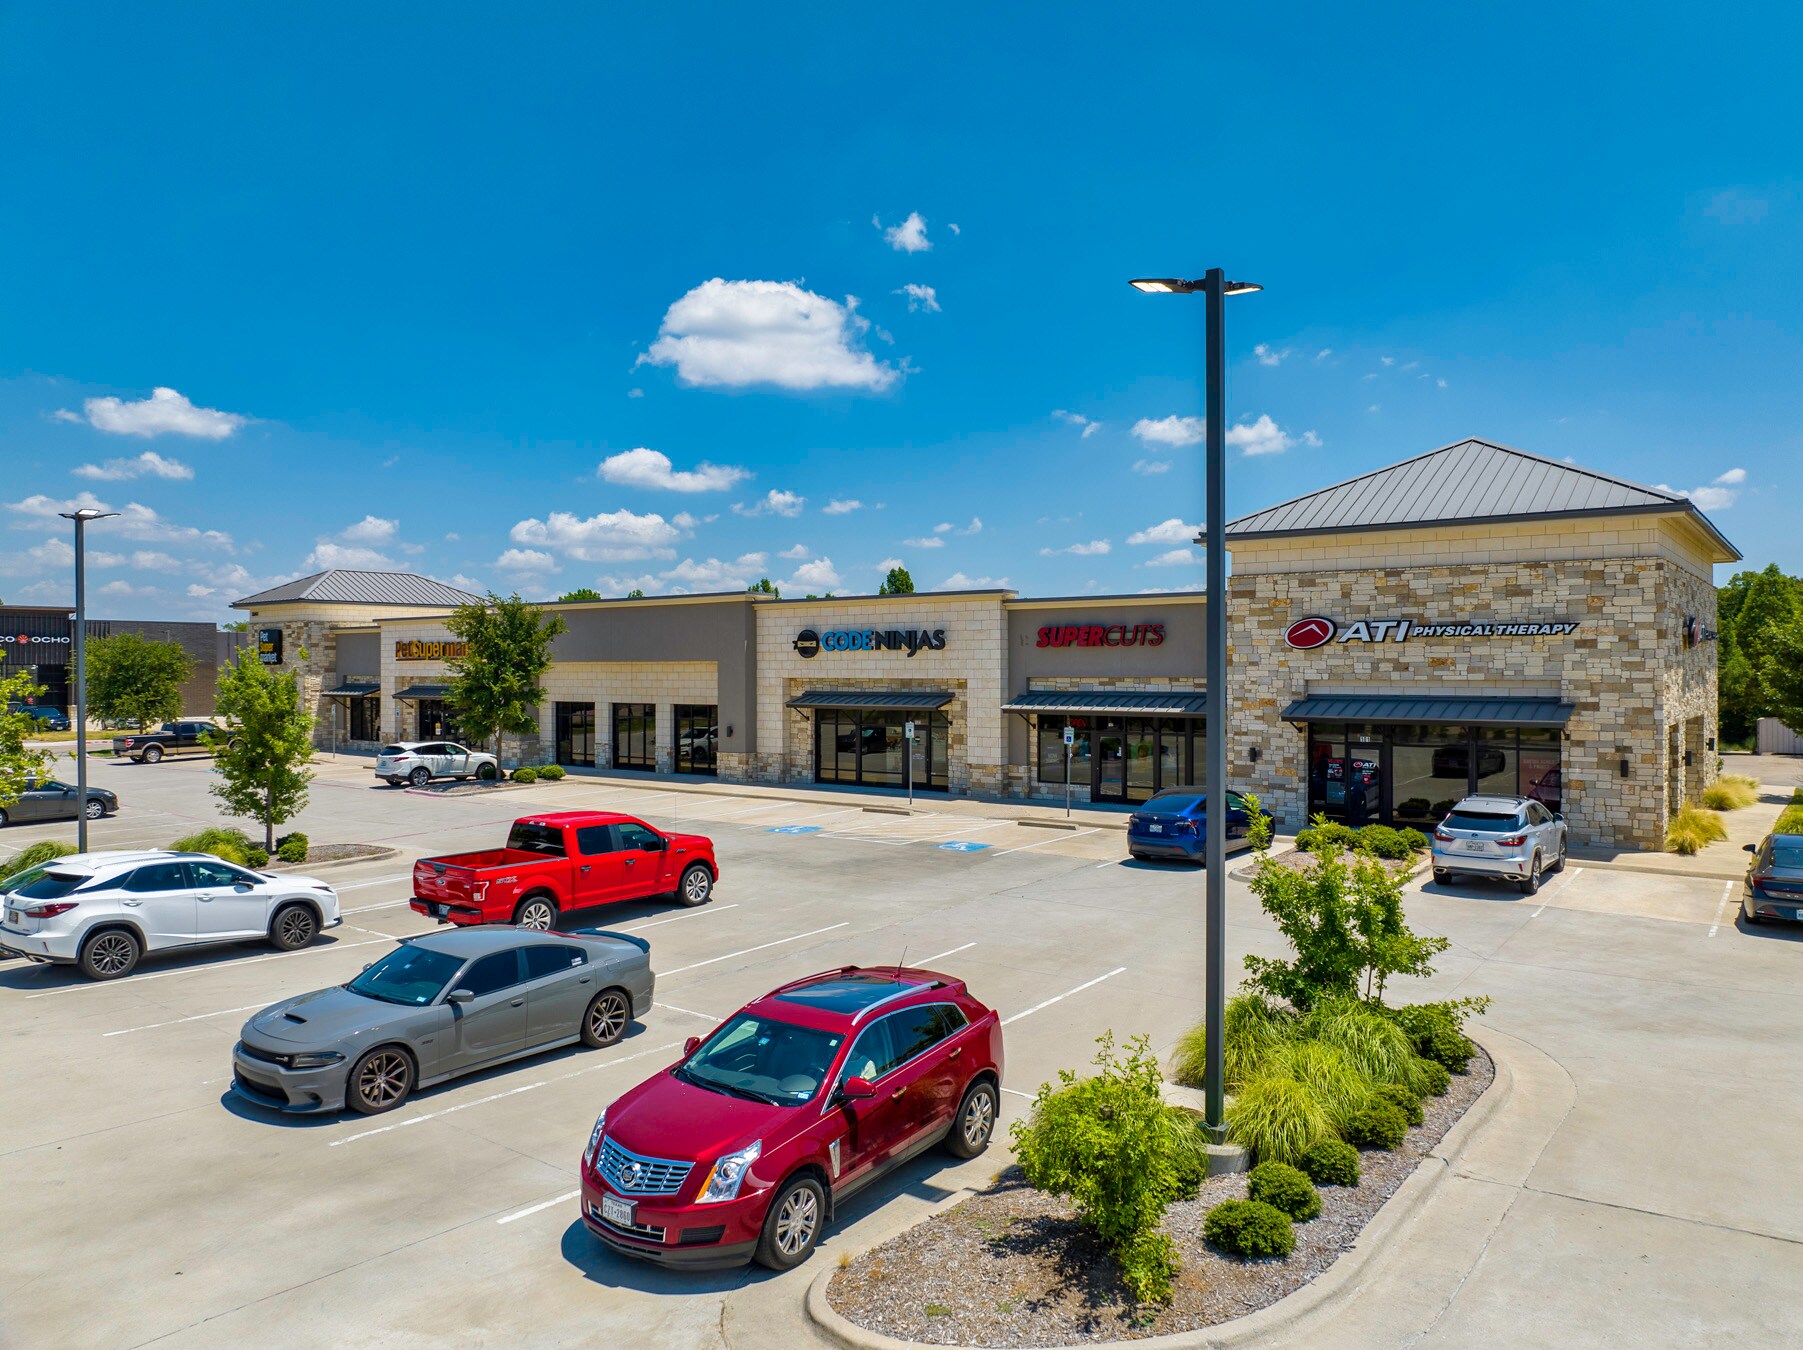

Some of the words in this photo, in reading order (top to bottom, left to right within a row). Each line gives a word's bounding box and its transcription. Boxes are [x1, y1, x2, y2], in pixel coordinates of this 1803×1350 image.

[260, 631, 269, 642] Pet
[1036, 624, 1165, 648] SUPERCUTS
[1338, 620, 1412, 643] ATI
[1413, 624, 1493, 637] PHYSICAL
[1496, 622, 1580, 636] THERAPY
[31, 636, 70, 644] OCHO
[260, 642, 274, 652] Super
[260, 652, 277, 663] market
